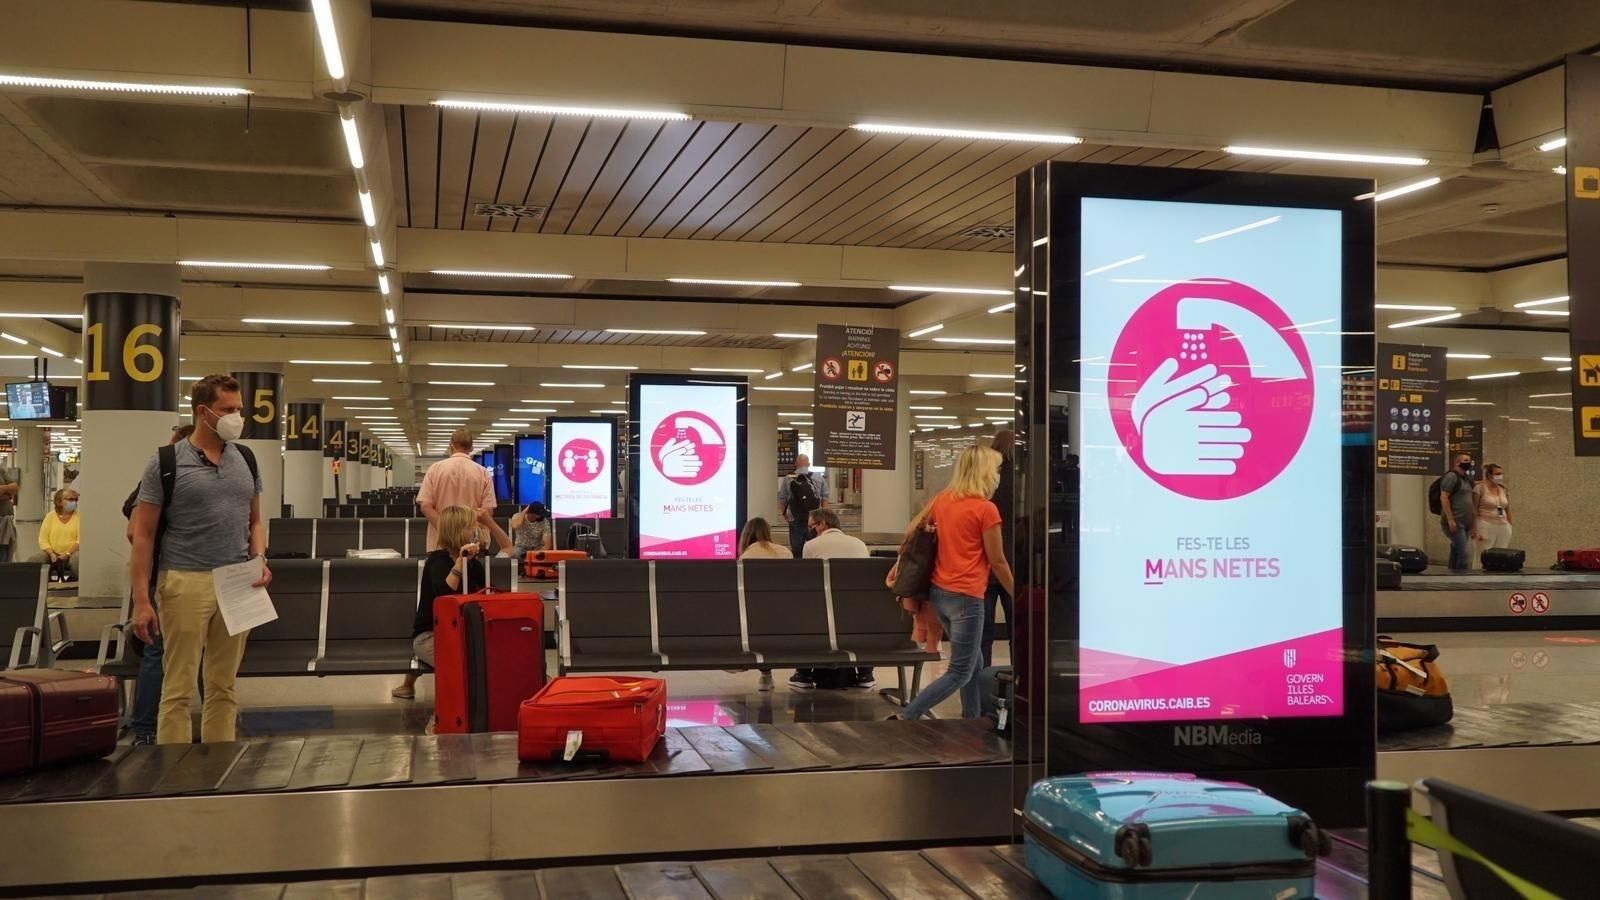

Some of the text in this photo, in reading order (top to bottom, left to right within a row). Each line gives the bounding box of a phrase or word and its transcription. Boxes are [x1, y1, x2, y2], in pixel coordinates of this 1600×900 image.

[87, 322, 164, 383] 16
[242, 389, 275, 424] 5
[287, 415, 320, 440] 14
[663, 504, 714, 512] MANS NETES
[1177, 537, 1250, 551] FES-TE LES
[1145, 558, 1281, 580] MANS NETES
[1286, 673, 1324, 684] GOVERN
[1287, 684, 1314, 694] ILLES
[1088, 697, 1211, 712] CORONAVIRUS.CAIB.ES
[1287, 695, 1328, 705] BALEARS
[1173, 725, 1262, 746] NBMedia
